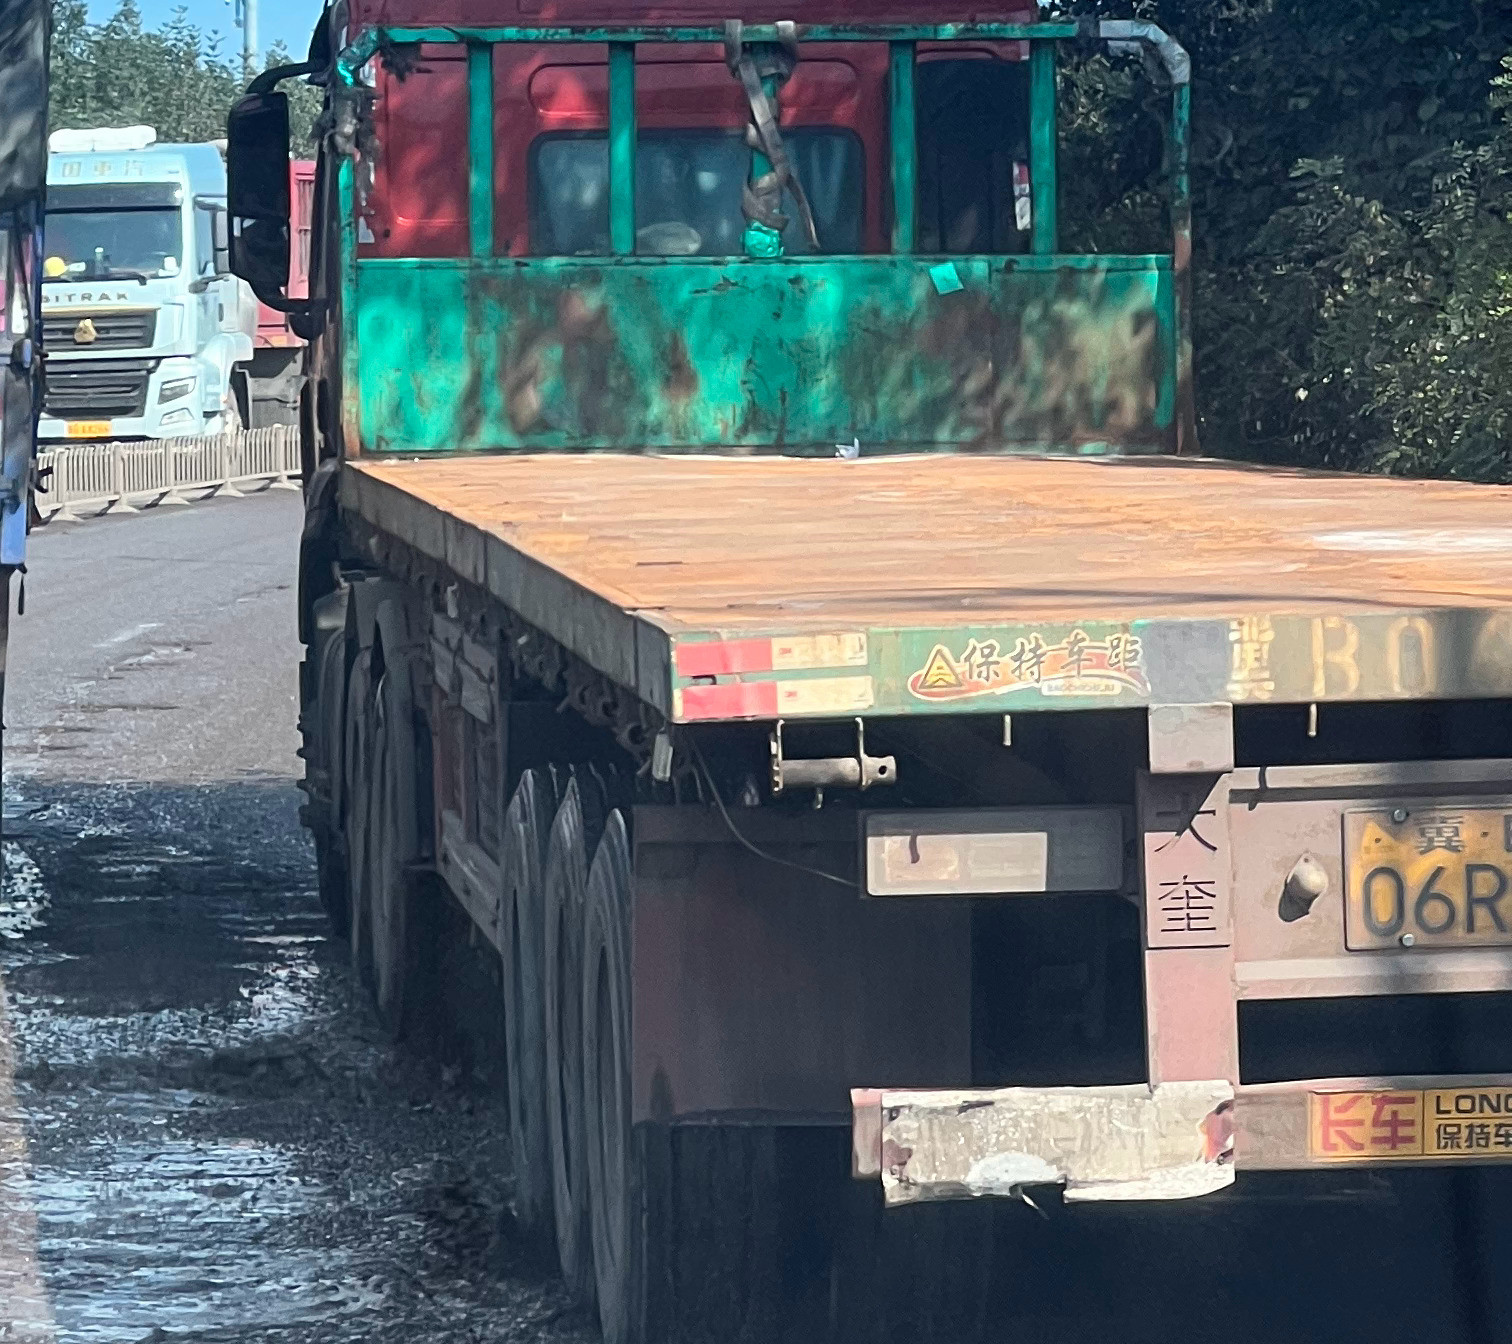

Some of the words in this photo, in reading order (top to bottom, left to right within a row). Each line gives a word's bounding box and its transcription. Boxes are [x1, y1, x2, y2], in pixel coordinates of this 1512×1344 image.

[963, 629, 1142, 684] 保持车距
[1363, 863, 1509, 937] 06R
[1321, 1094, 1417, 1153] 长车
